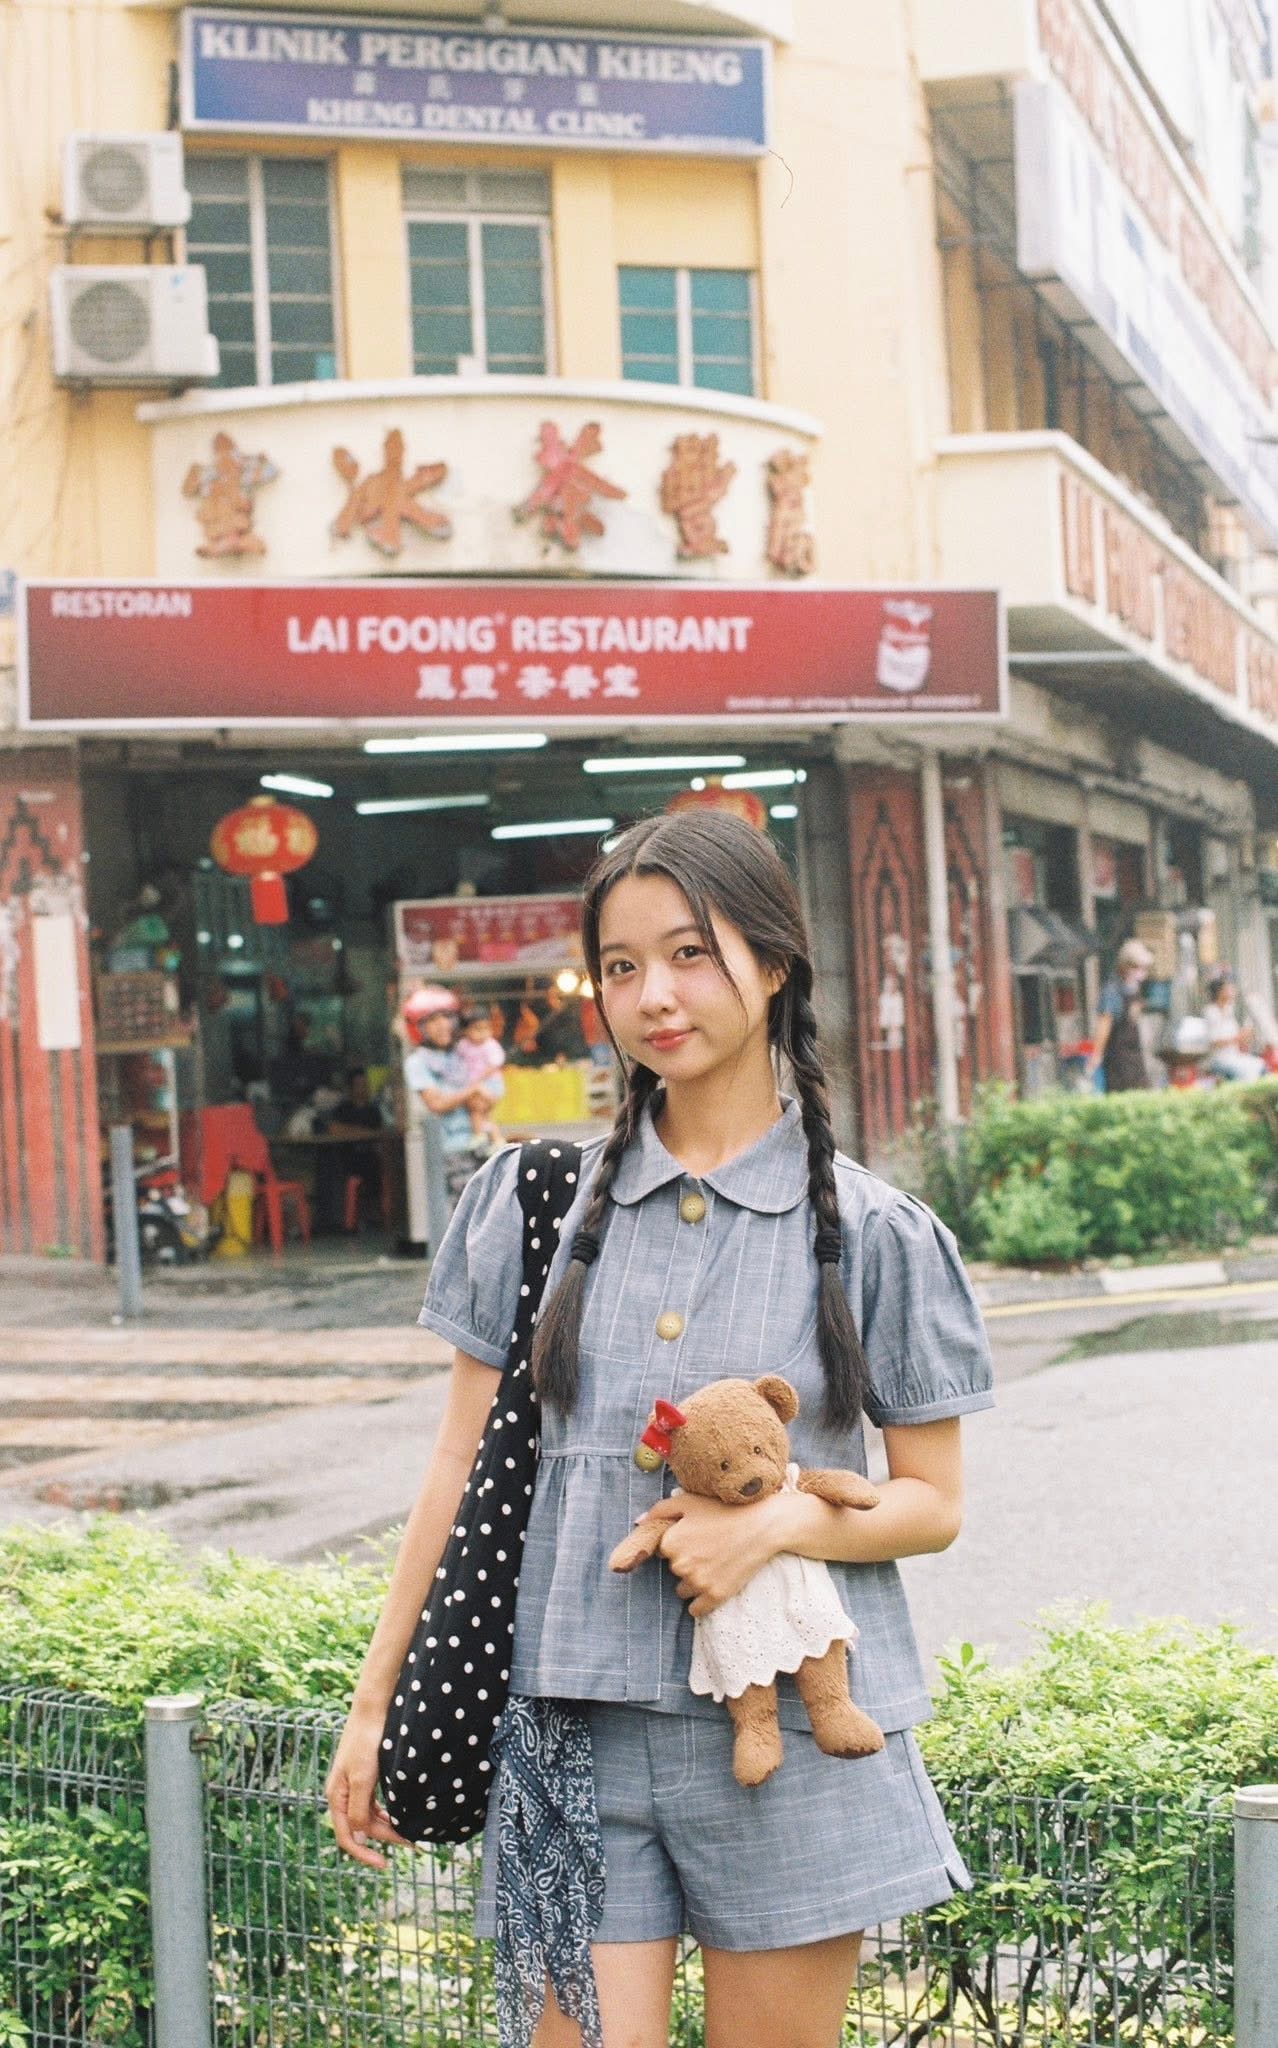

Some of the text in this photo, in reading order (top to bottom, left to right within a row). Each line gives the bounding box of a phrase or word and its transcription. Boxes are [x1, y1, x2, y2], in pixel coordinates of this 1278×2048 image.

[201, 23, 744, 87] KLINIK PERGIGIAN KHENG
[307, 98, 646, 138] KHENG DENTAL CLINIC
[51, 590, 192, 618] RESTORAN
[287, 615, 753, 654] LAI FOONG RESTAURANT
